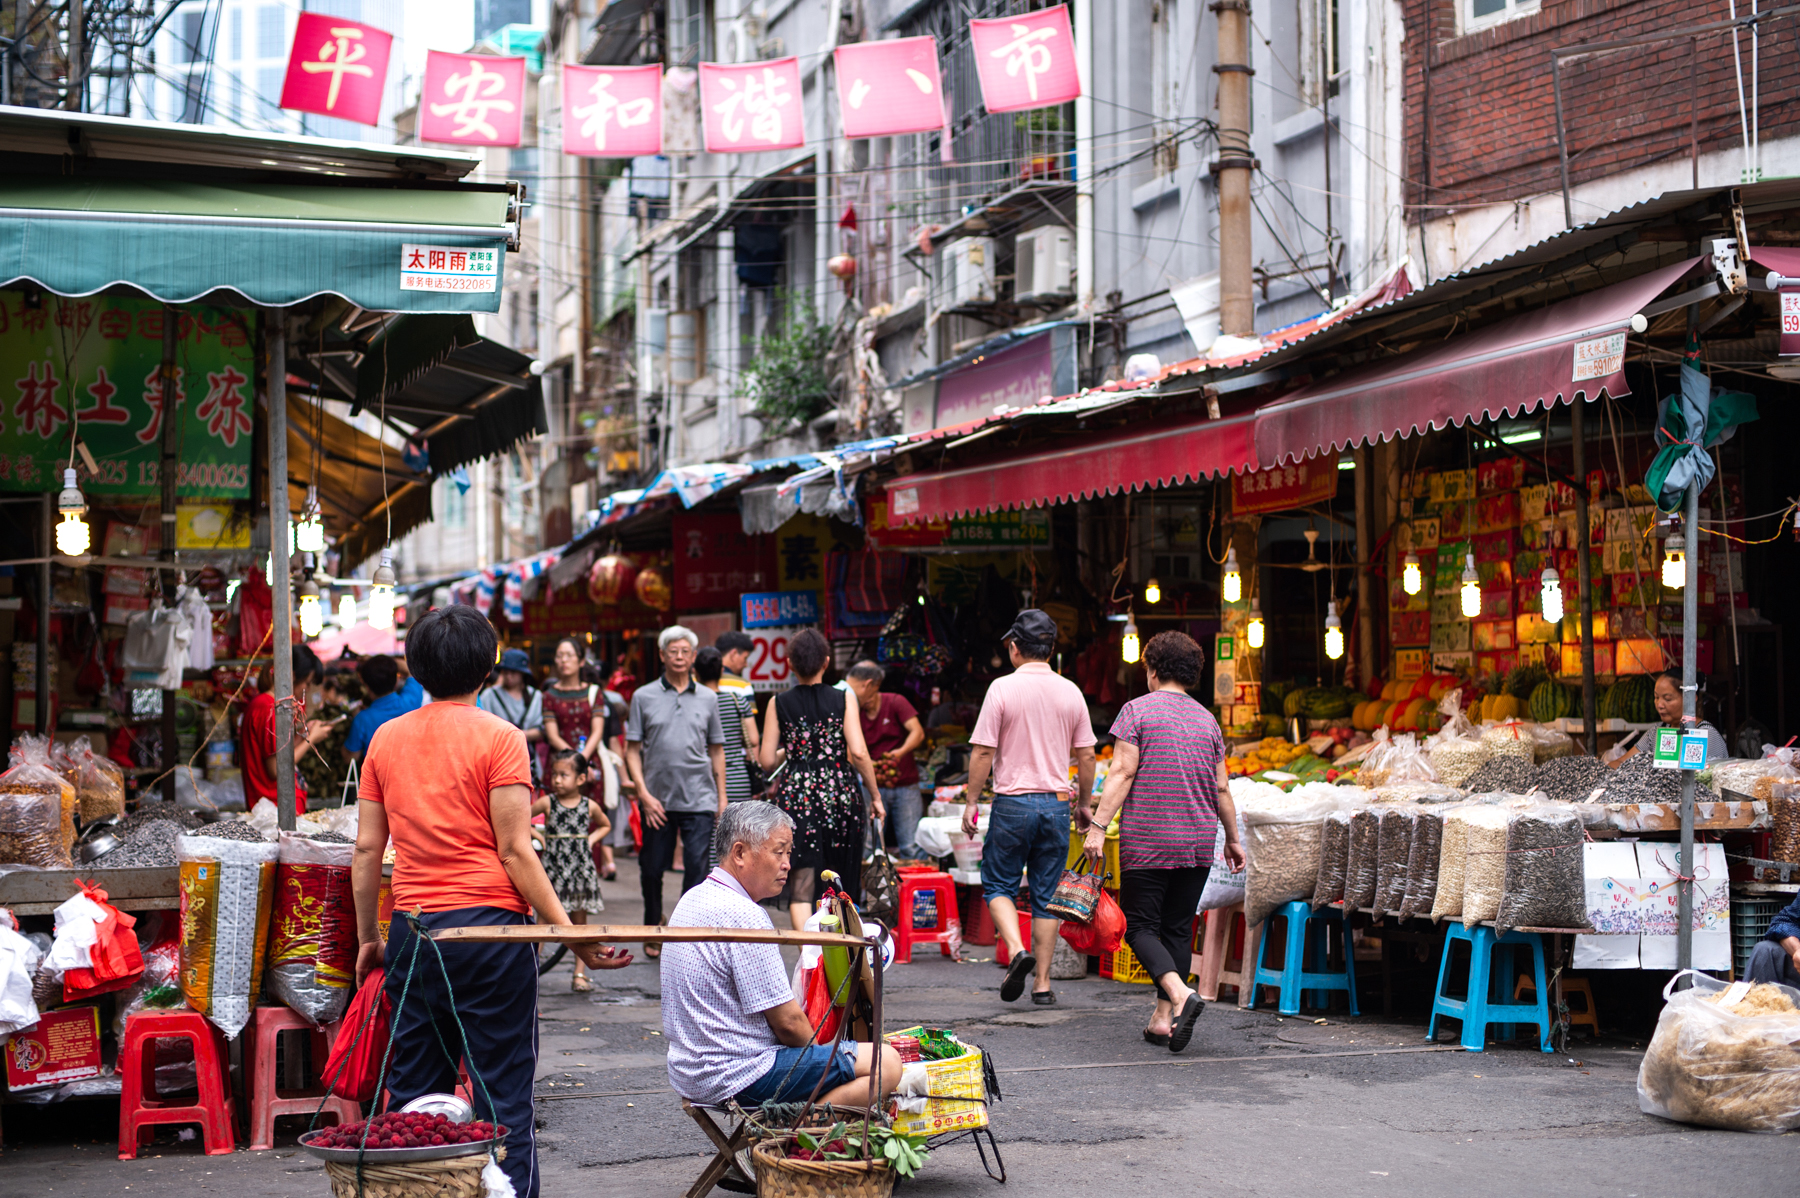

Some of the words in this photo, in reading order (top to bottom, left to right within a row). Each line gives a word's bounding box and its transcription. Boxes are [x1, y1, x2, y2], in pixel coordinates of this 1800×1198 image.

[301, 27, 373, 111] 平
[429, 59, 515, 141] 安
[571, 73, 655, 151] 和
[713, 67, 793, 145] 谐
[989, 23, 1058, 101] 市
[407, 248, 468, 271] 太阳雨
[468, 262, 493, 272] 太阳伞
[0, 360, 253, 448] 林土笋冻
[137, 460, 249, 489] 138400625
[749, 635, 790, 681] 29
